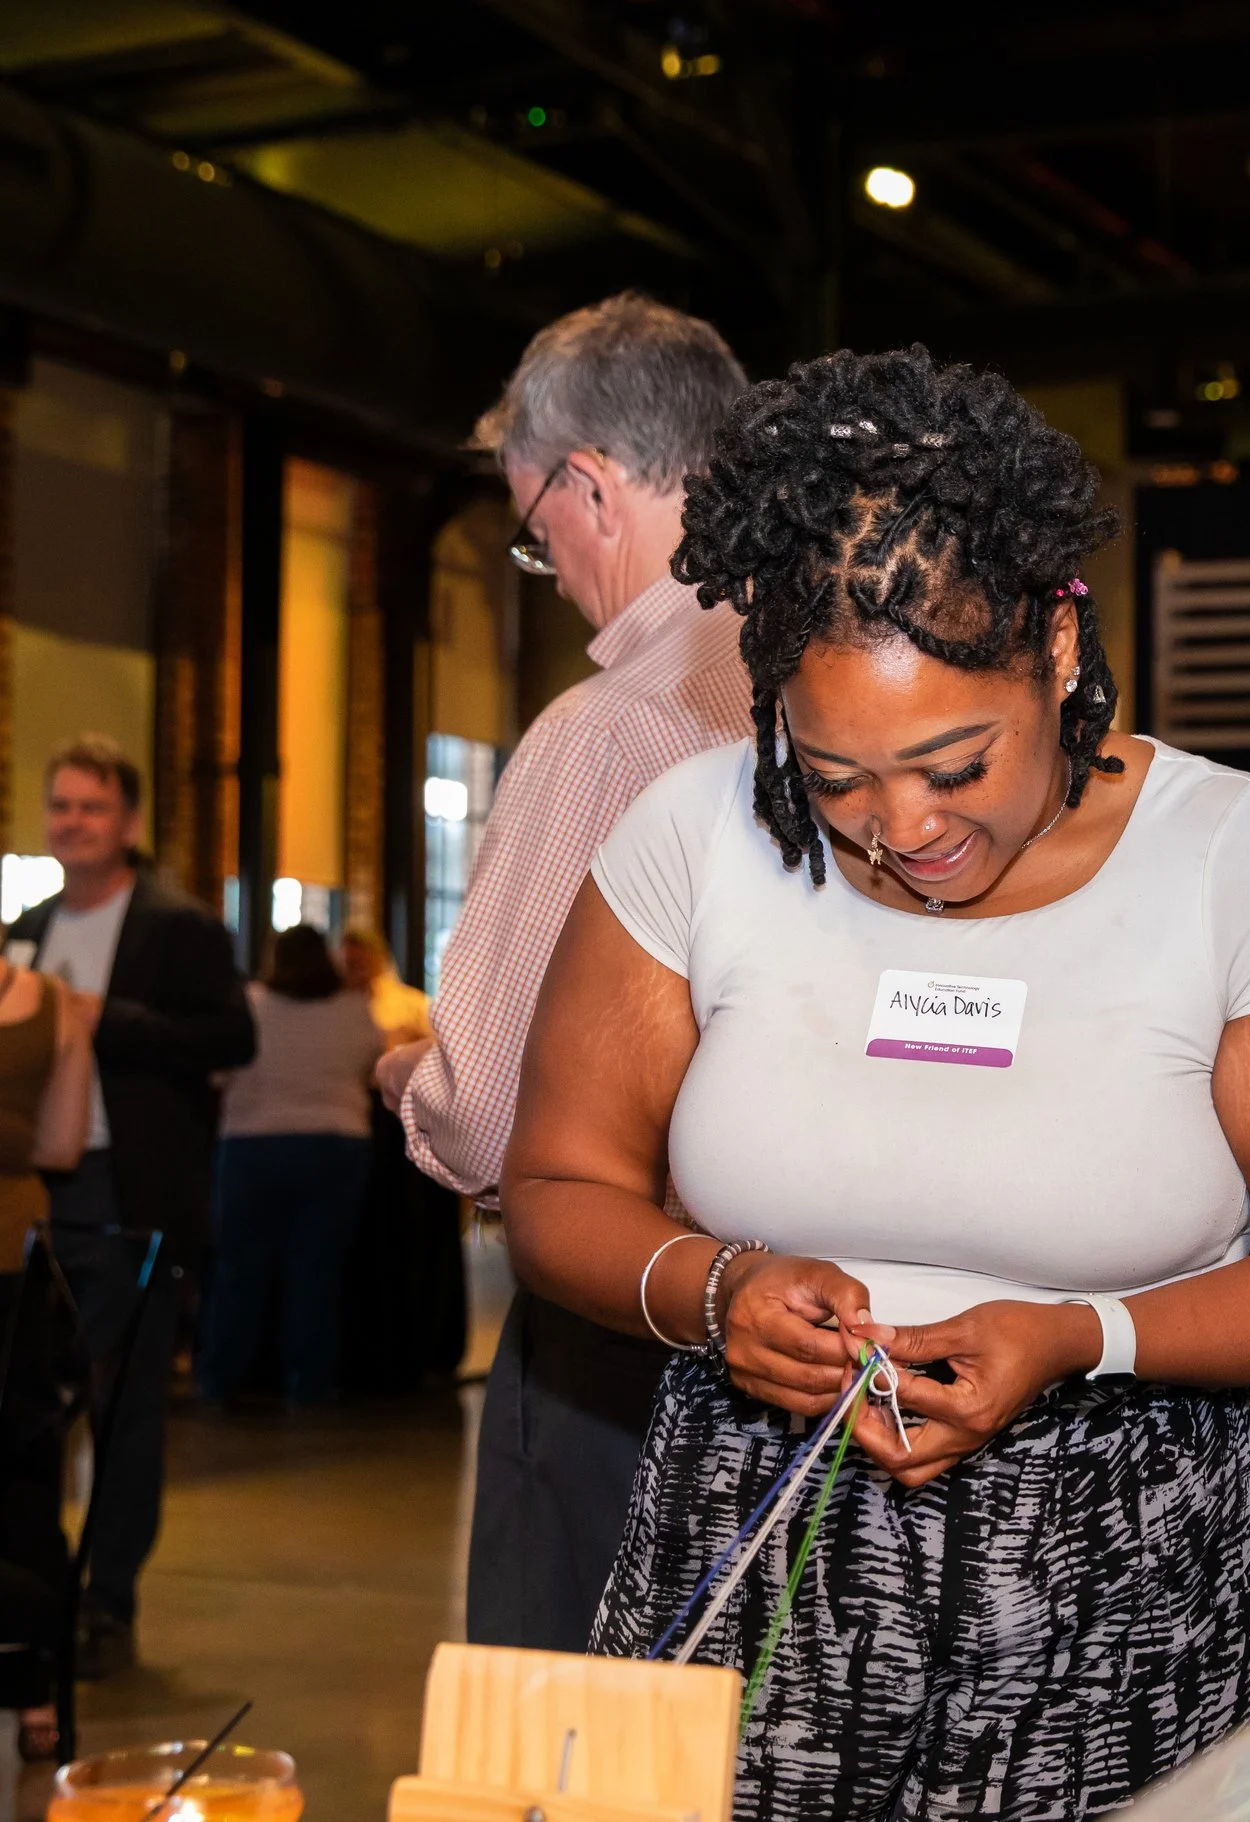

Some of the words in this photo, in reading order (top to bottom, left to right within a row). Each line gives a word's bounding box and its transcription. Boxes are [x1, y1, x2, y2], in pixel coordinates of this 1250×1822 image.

[954, 996, 1002, 1018] Davis
[924, 1044, 950, 1052] Friend
[961, 1047, 978, 1055] ITEF
